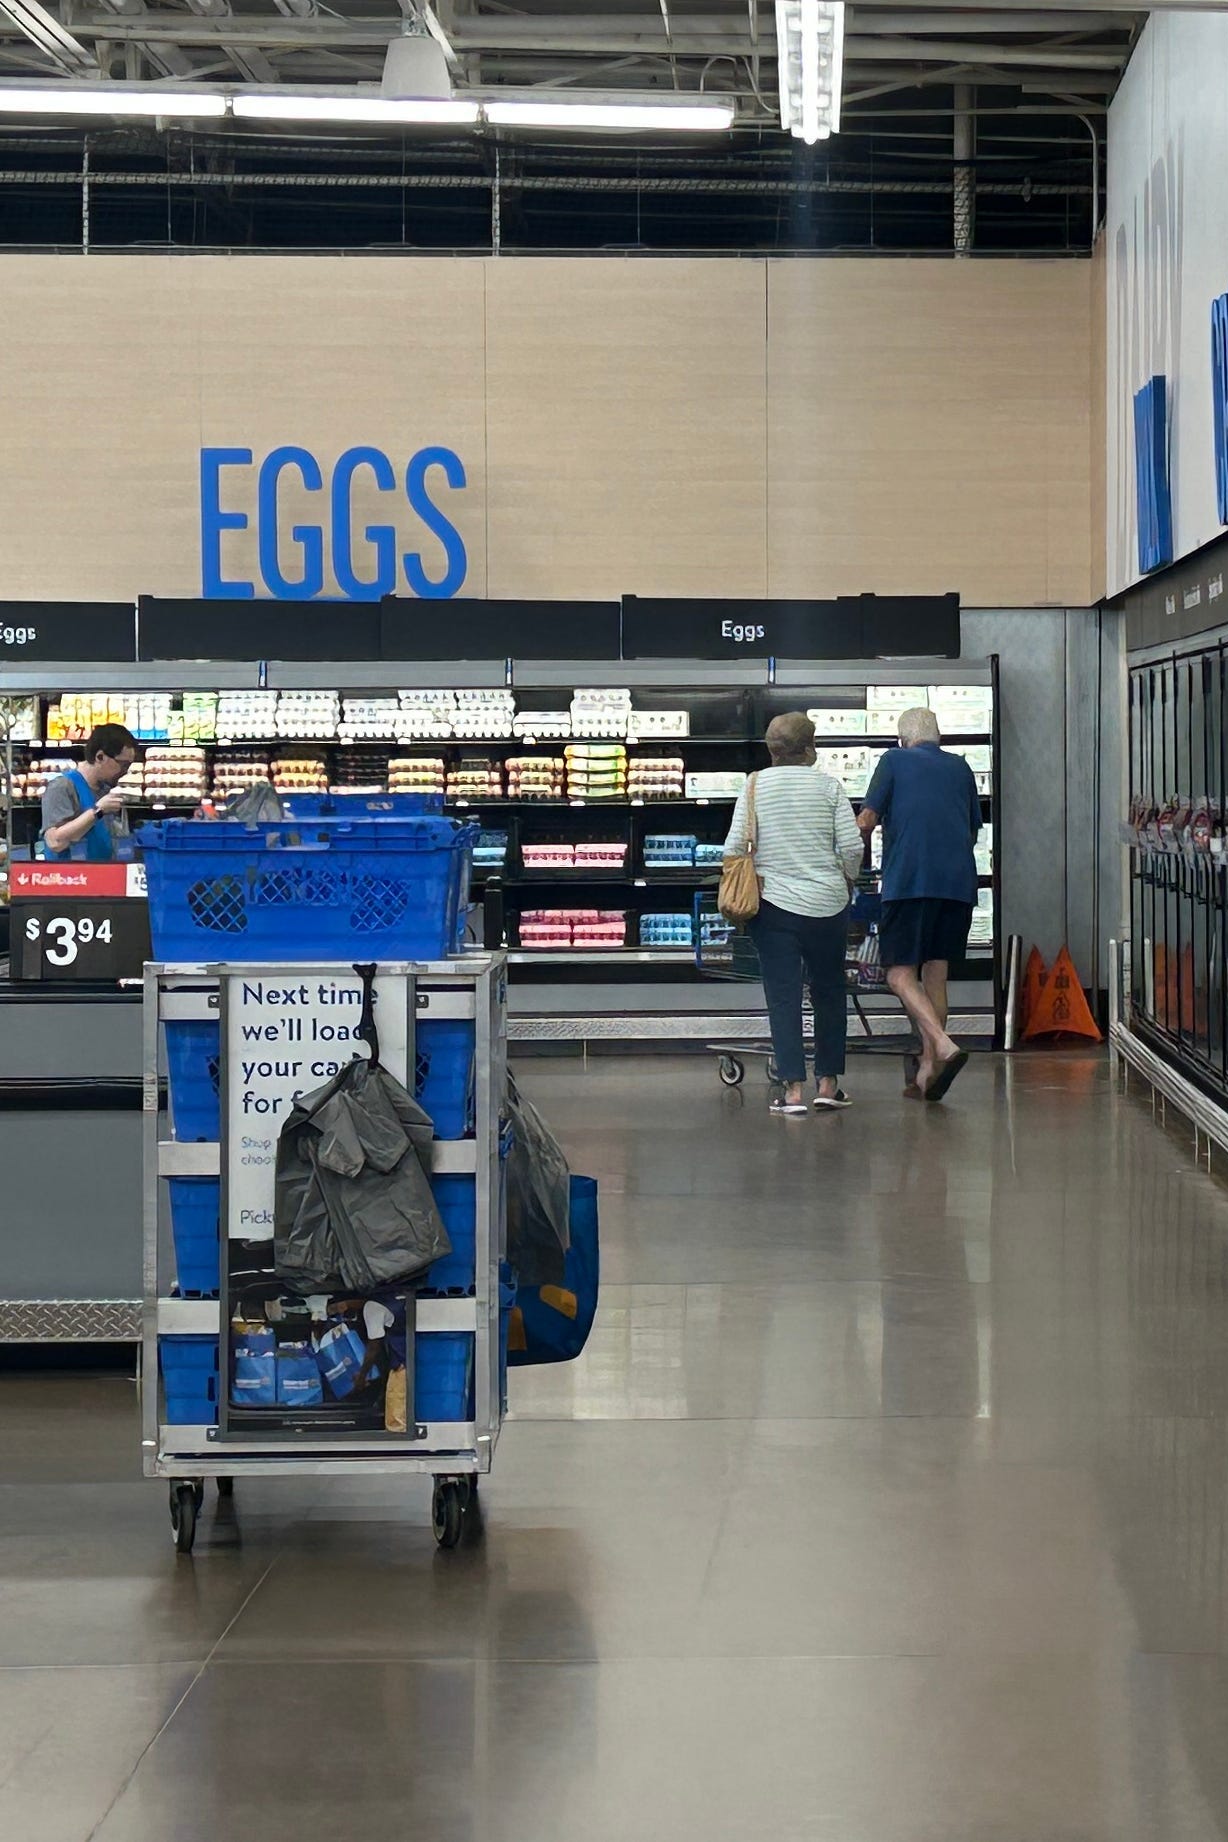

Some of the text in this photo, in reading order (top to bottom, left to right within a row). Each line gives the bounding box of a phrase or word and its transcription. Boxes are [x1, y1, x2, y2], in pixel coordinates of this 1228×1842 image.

[200, 446, 468, 599] EGGS
[721, 620, 766, 642] Eggs
[31, 872, 88, 886] Rollback
[242, 982, 310, 1006] Next
[241, 1018, 302, 1041] we'll
[241, 1061, 303, 1085] your
[242, 1090, 283, 1114] for
[241, 1154, 275, 1166] choo
[240, 1209, 274, 1225] Pick
